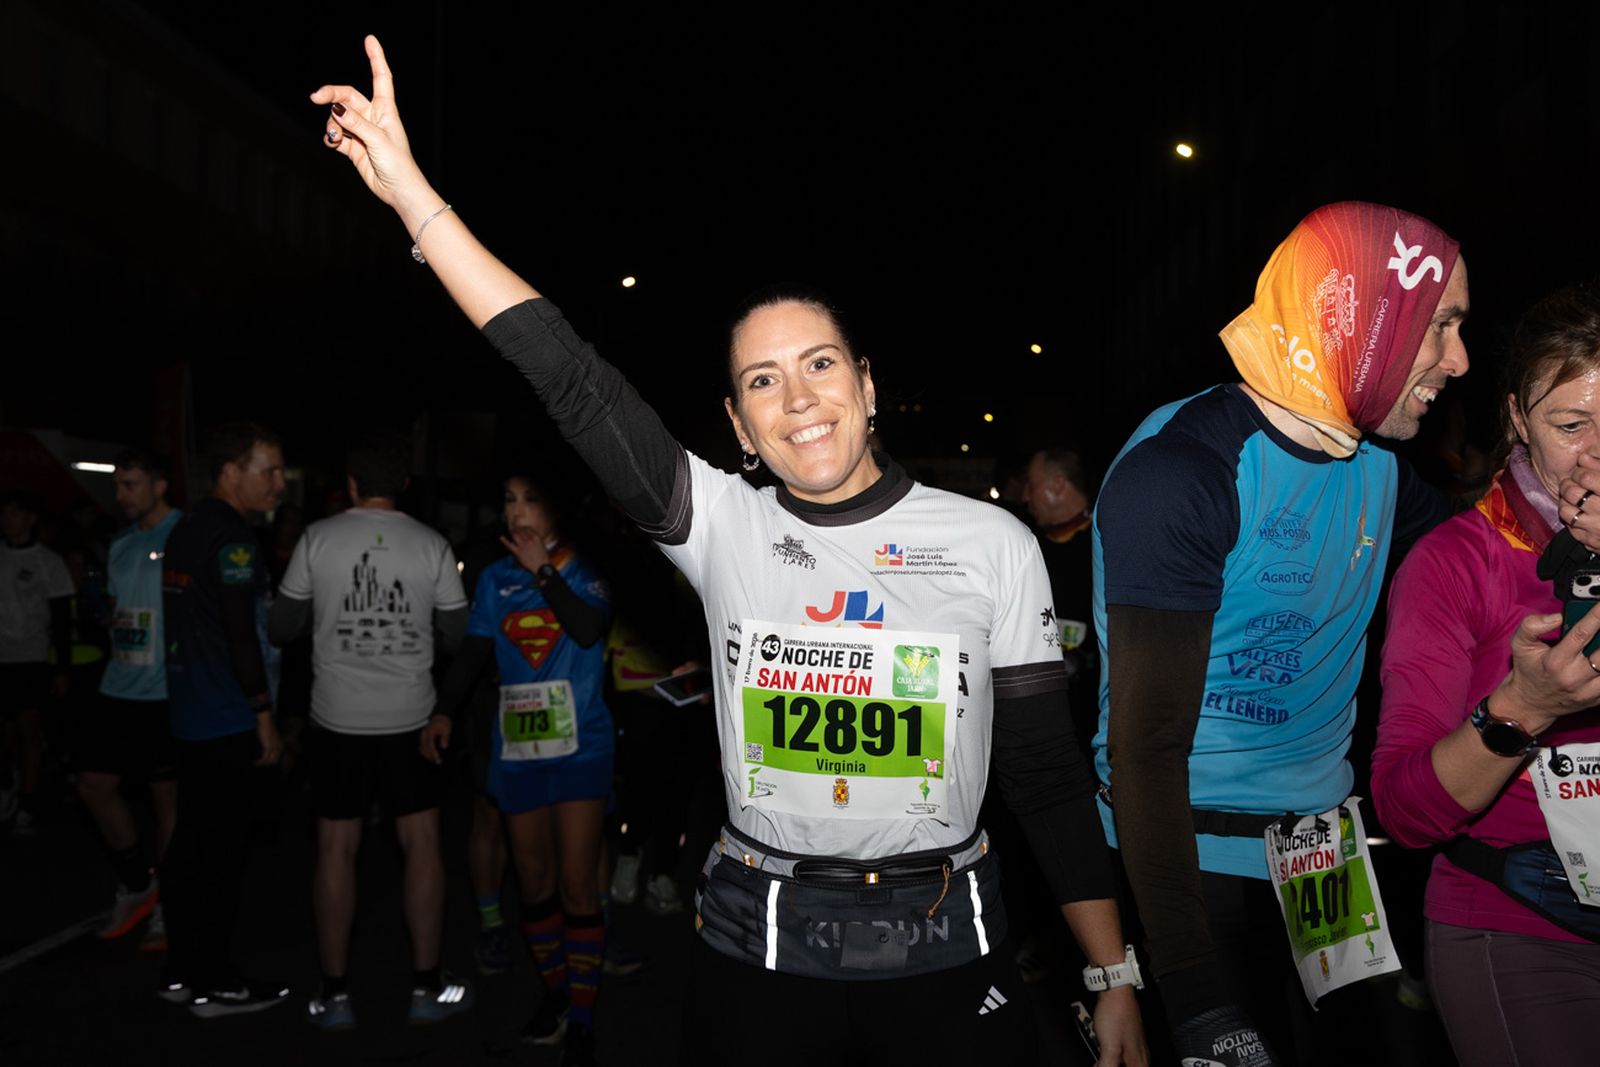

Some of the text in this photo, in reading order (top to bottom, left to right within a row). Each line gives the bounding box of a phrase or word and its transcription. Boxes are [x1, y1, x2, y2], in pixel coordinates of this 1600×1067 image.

[1367, 298, 1389, 351] CARRERA
[1354, 351, 1373, 393] URBANA
[761, 640, 780, 654] 43
[784, 638, 806, 647] CARRERA
[830, 642, 873, 651] INTERNACIONAL
[781, 647, 874, 670] NOCHE DE
[1228, 655, 1293, 684] VERA
[757, 668, 797, 691] SAN
[801, 669, 872, 696] ANTÓN
[1205, 691, 1222, 710] EL
[517, 710, 550, 734] 773
[763, 695, 922, 757] 12891
[816, 758, 866, 775] Virginia
[1559, 778, 1600, 800] SAN
[1291, 846, 1334, 875] ANTÓN
[1212, 1030, 1260, 1056] ANTÓN
[1237, 1041, 1265, 1058] SAN
